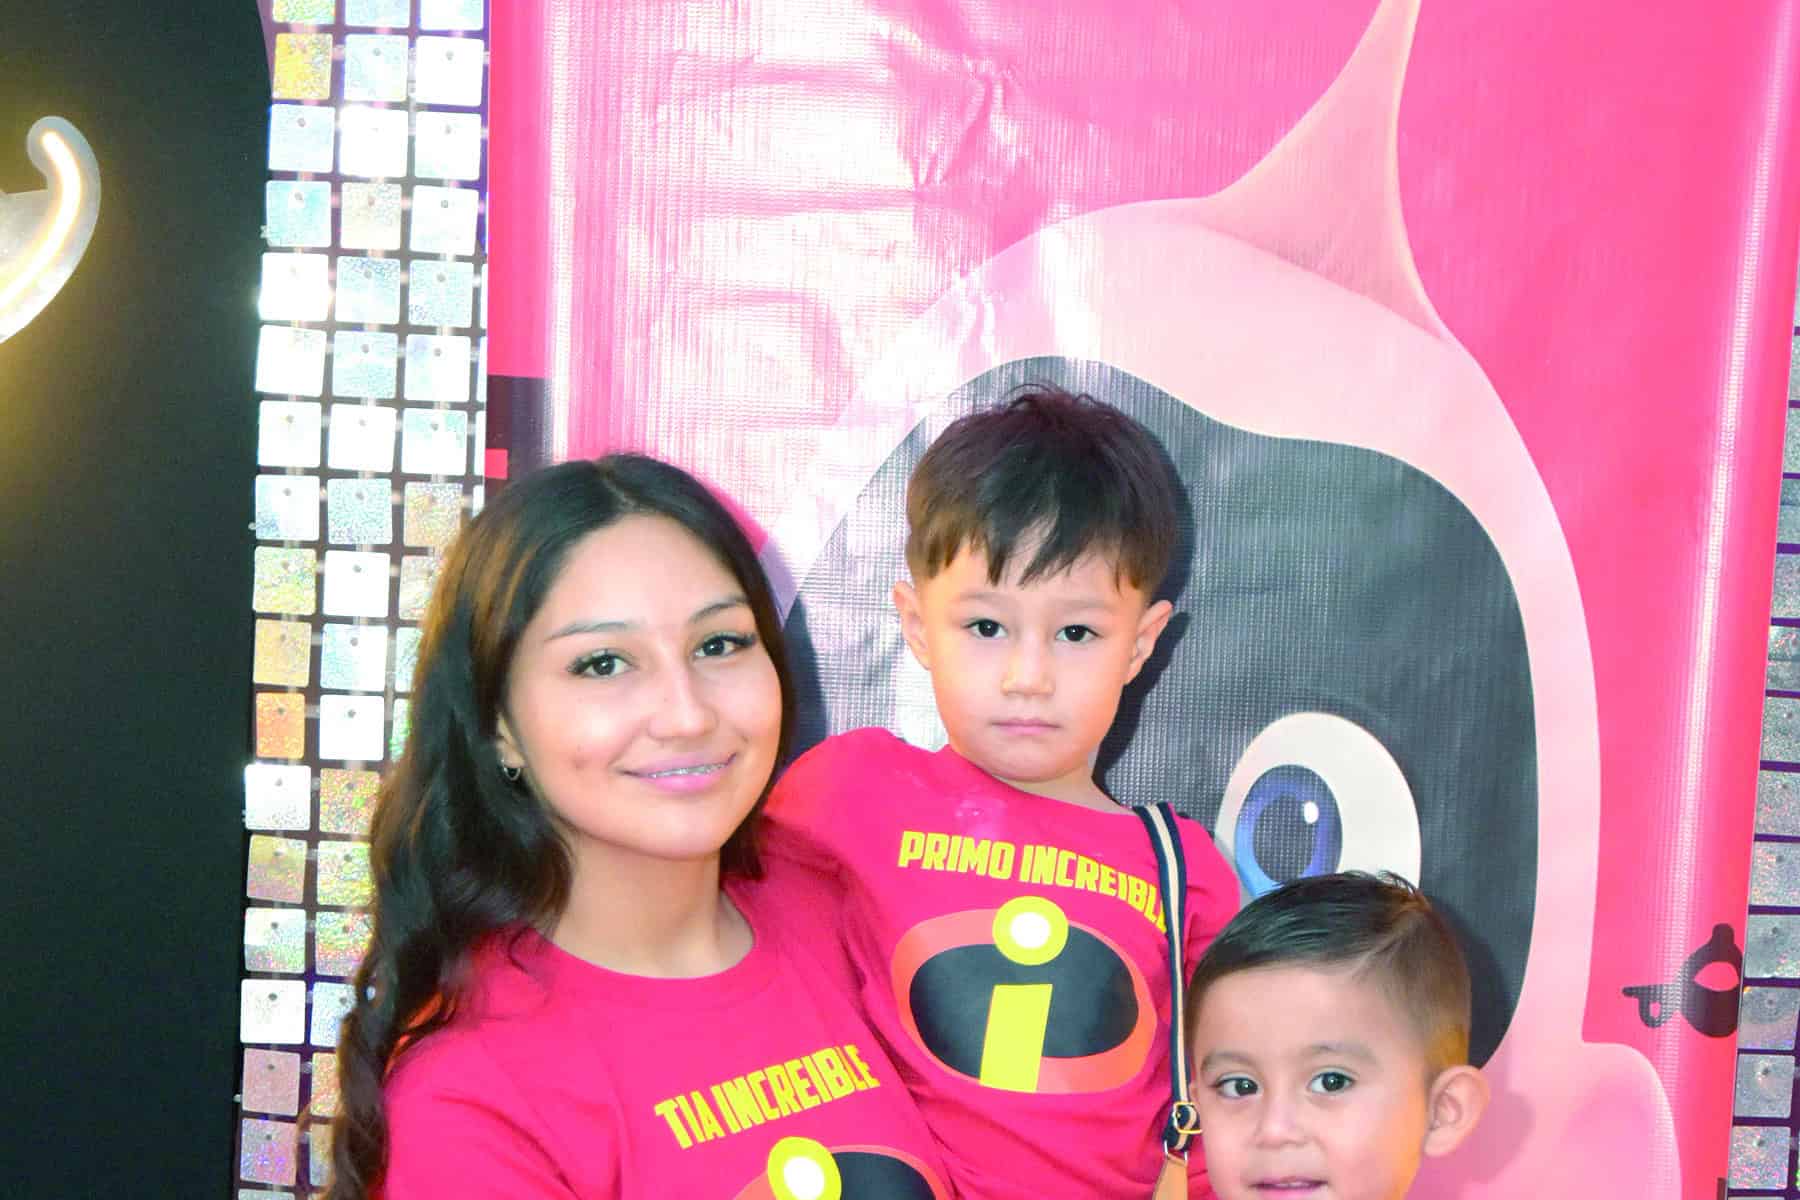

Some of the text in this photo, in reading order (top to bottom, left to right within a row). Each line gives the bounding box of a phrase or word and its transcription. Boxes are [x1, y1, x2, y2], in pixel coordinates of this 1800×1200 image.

[898, 831, 1016, 880] PRIMO
[654, 1044, 881, 1150] TIA INCREIBLE
